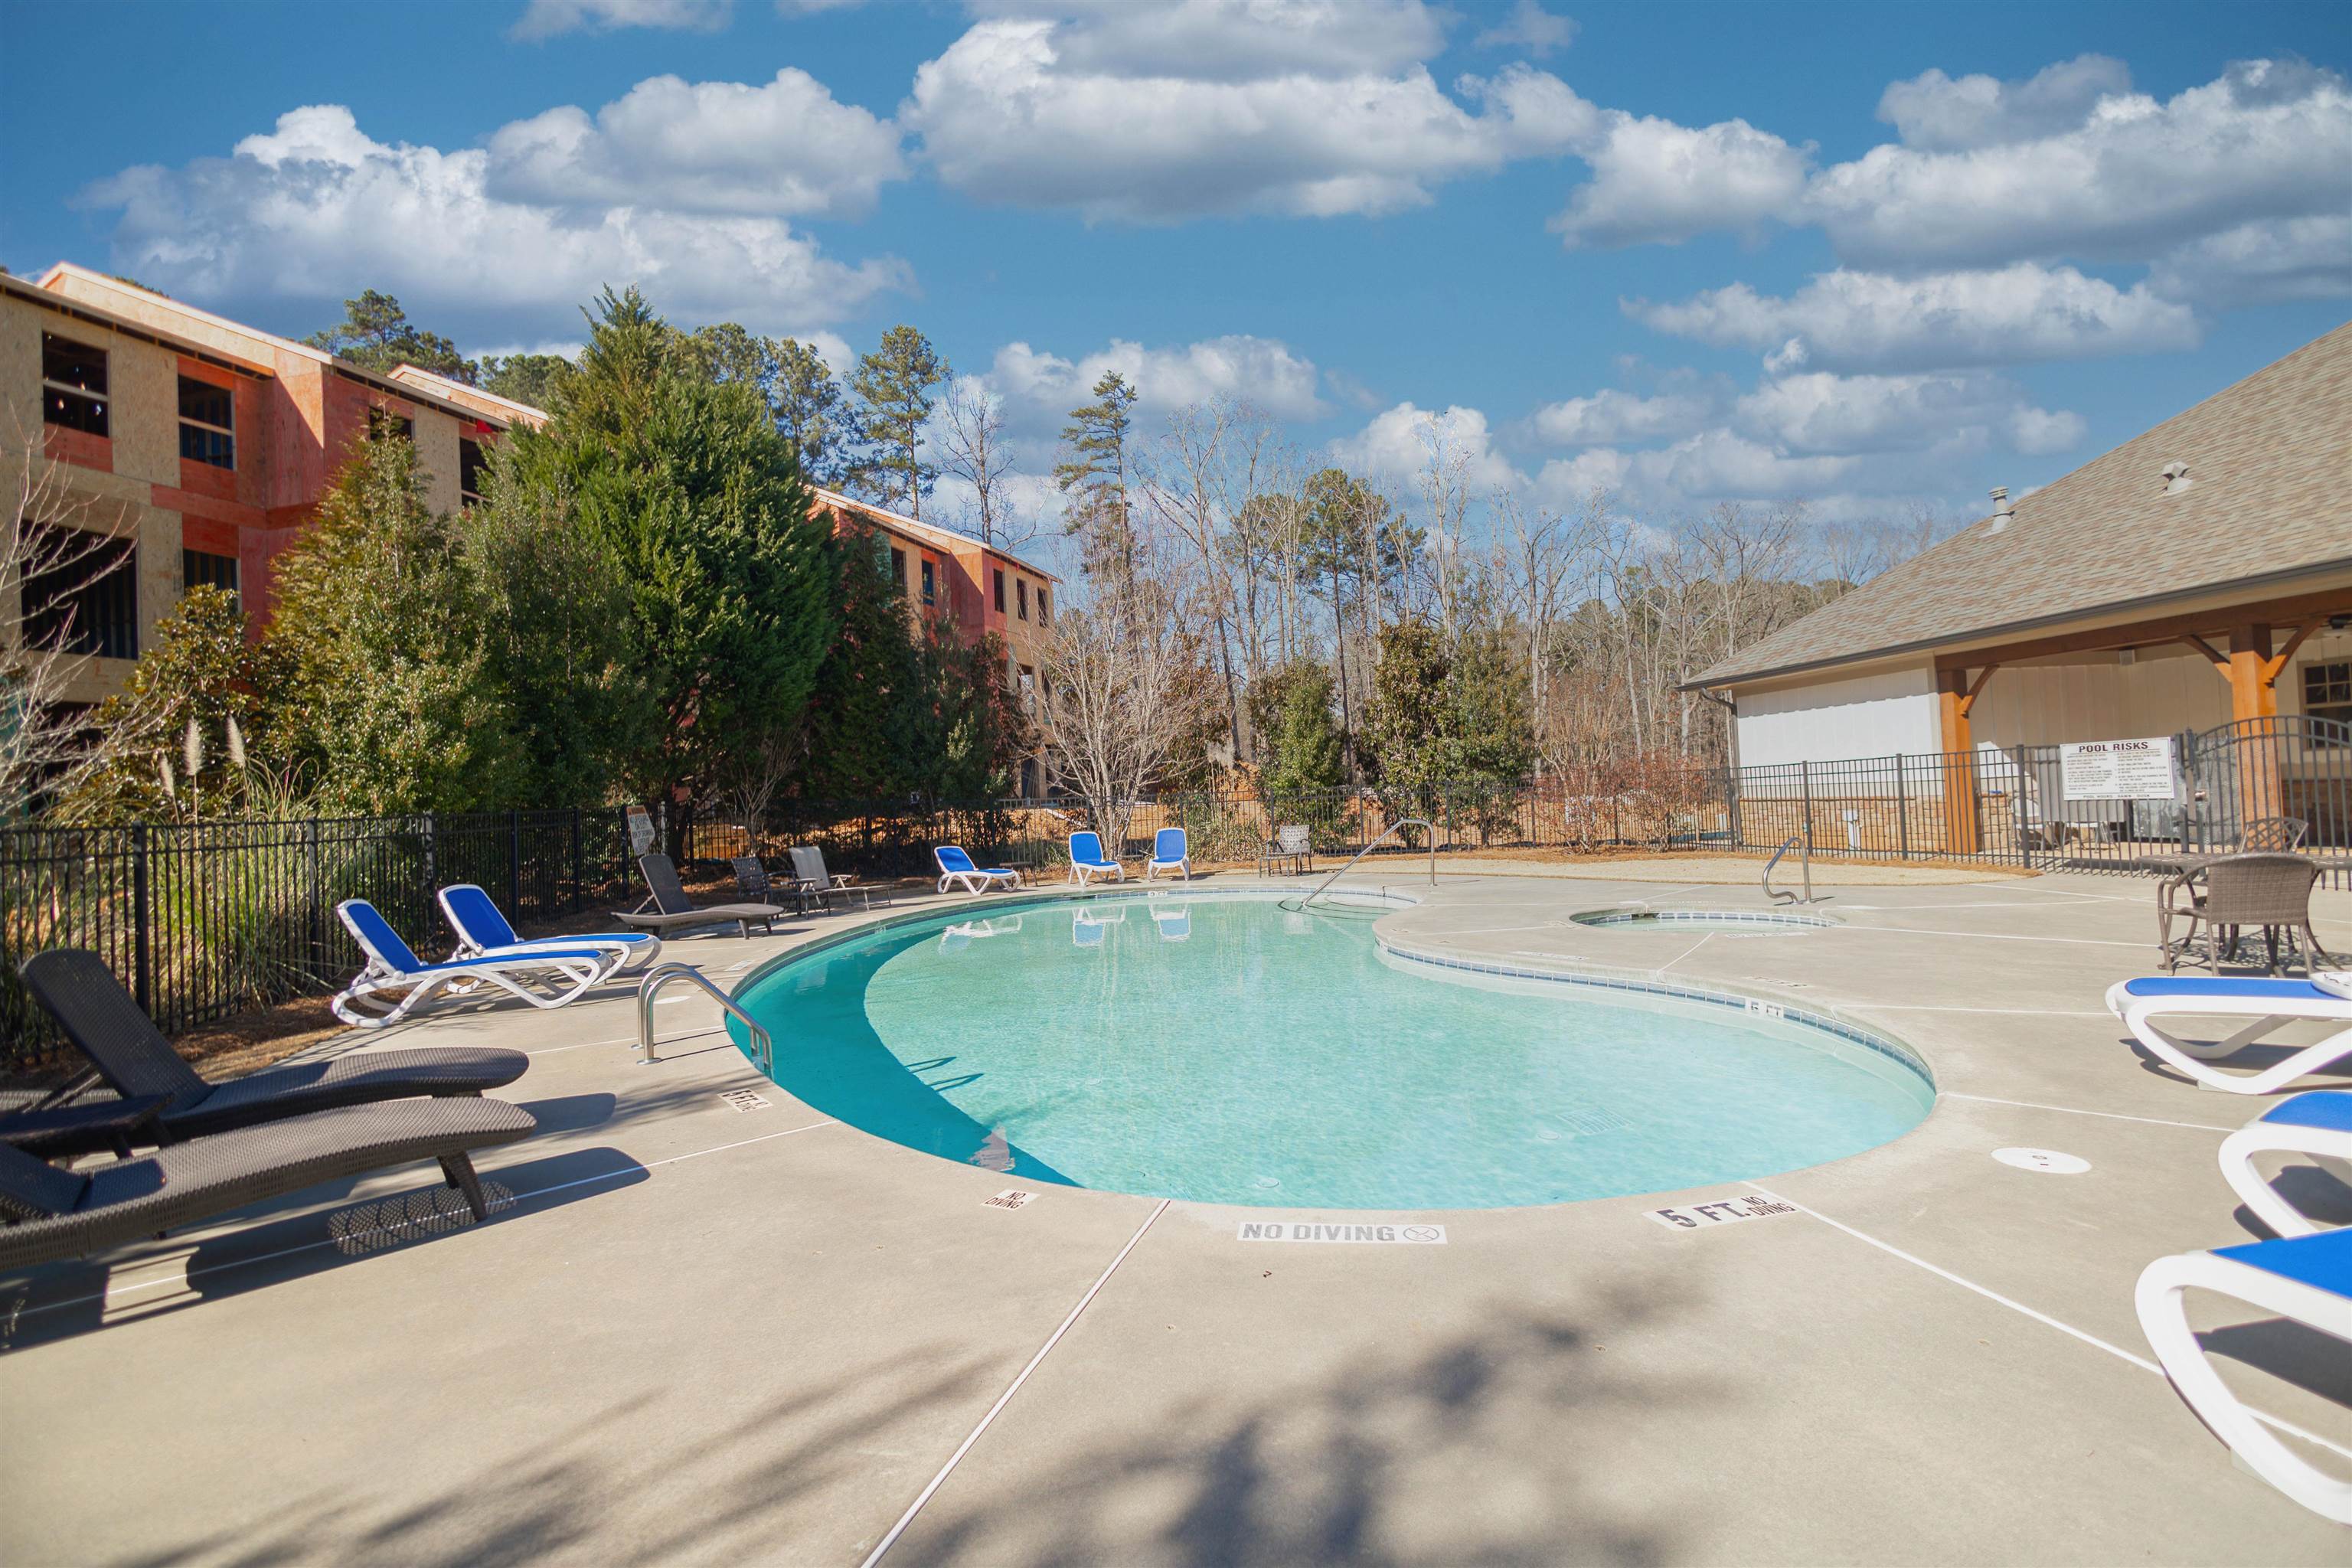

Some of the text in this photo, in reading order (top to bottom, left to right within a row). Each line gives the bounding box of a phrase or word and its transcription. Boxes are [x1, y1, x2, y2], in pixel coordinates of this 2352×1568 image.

[2113, 742, 2148, 750] RISKS
[985, 1197, 1024, 1209] DIVING
[1741, 1196, 1767, 1206] NO
[1656, 1203, 1751, 1228] 5 FT.
[1747, 1203, 1795, 1216] DIVING
[1243, 1223, 1396, 1241] NO DIVING
